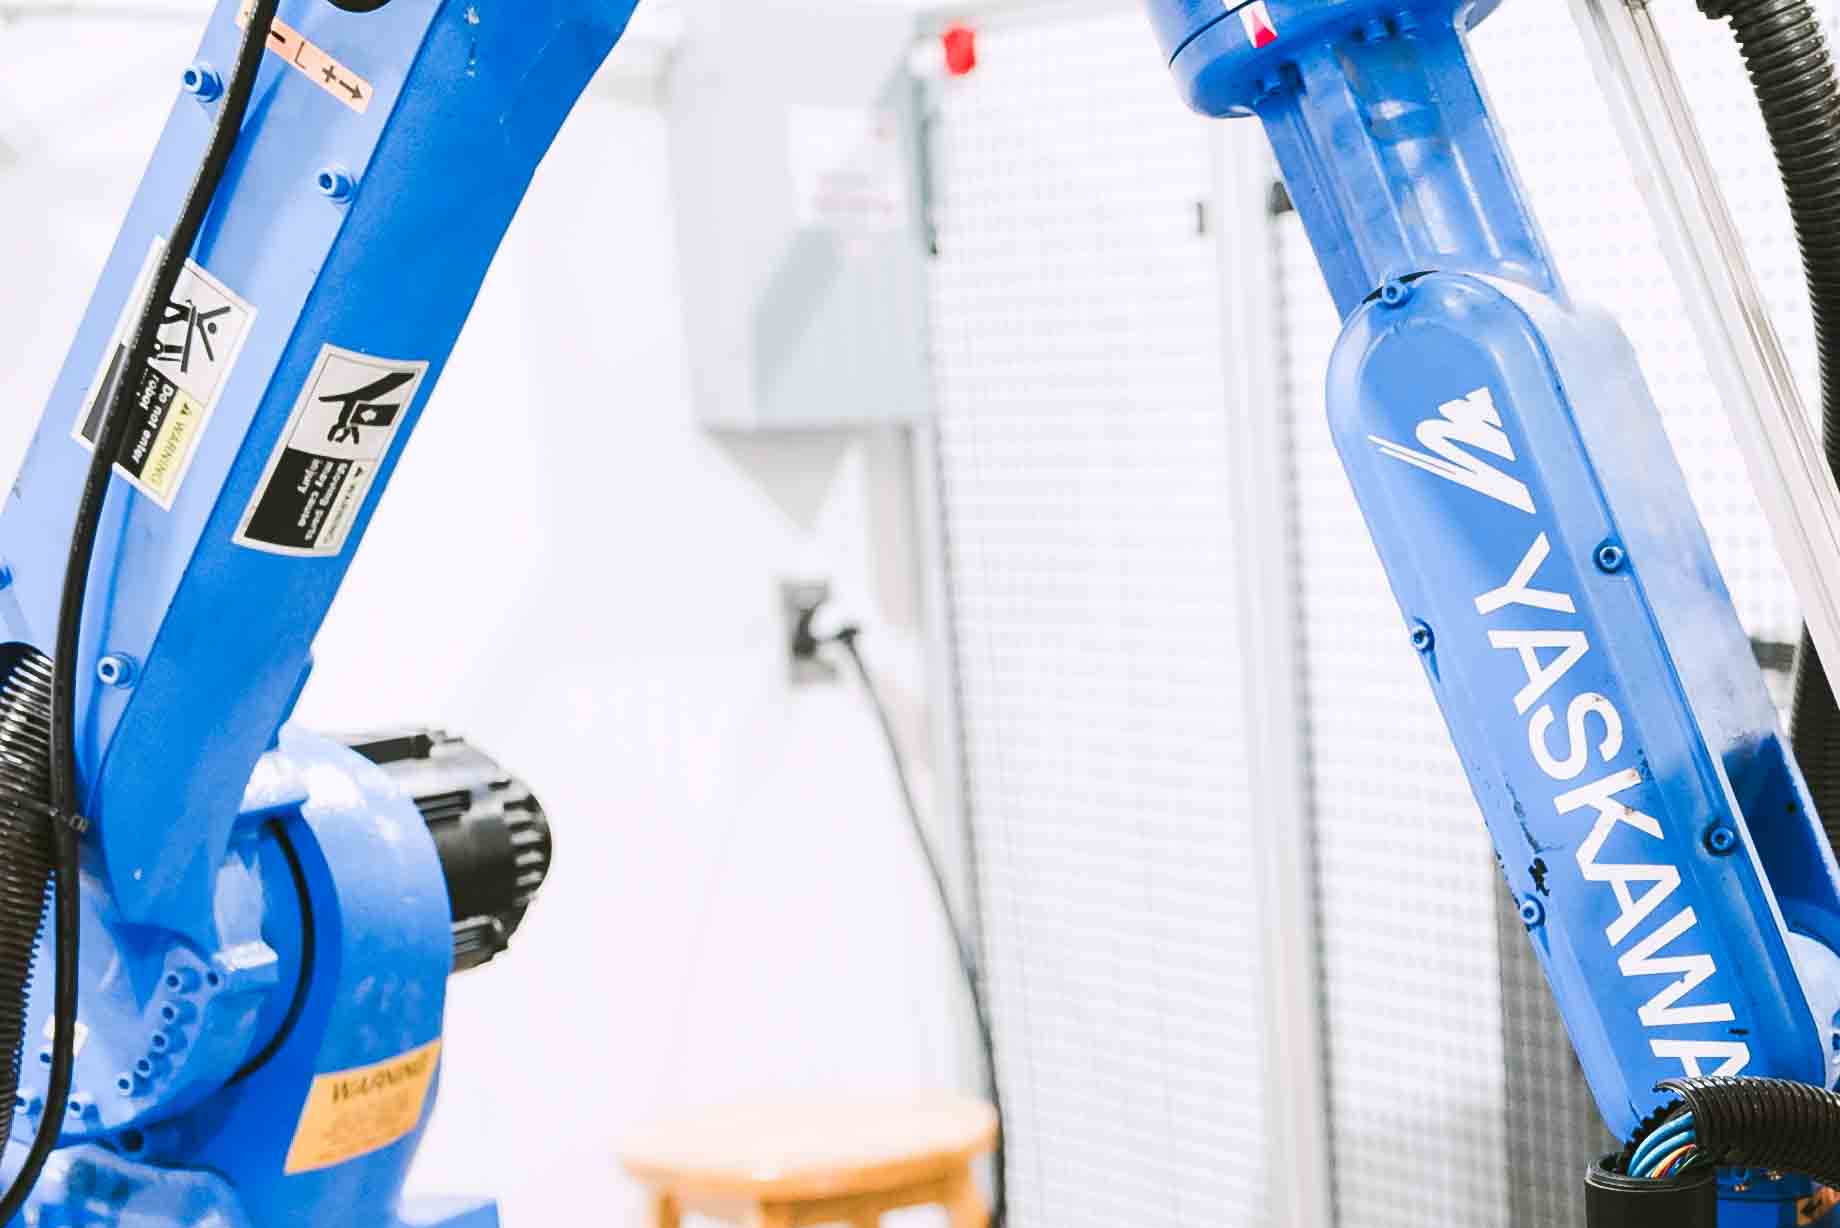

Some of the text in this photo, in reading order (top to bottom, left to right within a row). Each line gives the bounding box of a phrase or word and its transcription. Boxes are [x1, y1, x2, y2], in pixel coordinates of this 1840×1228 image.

[138, 374, 160, 411] robot
[131, 384, 175, 464] Do not enter
